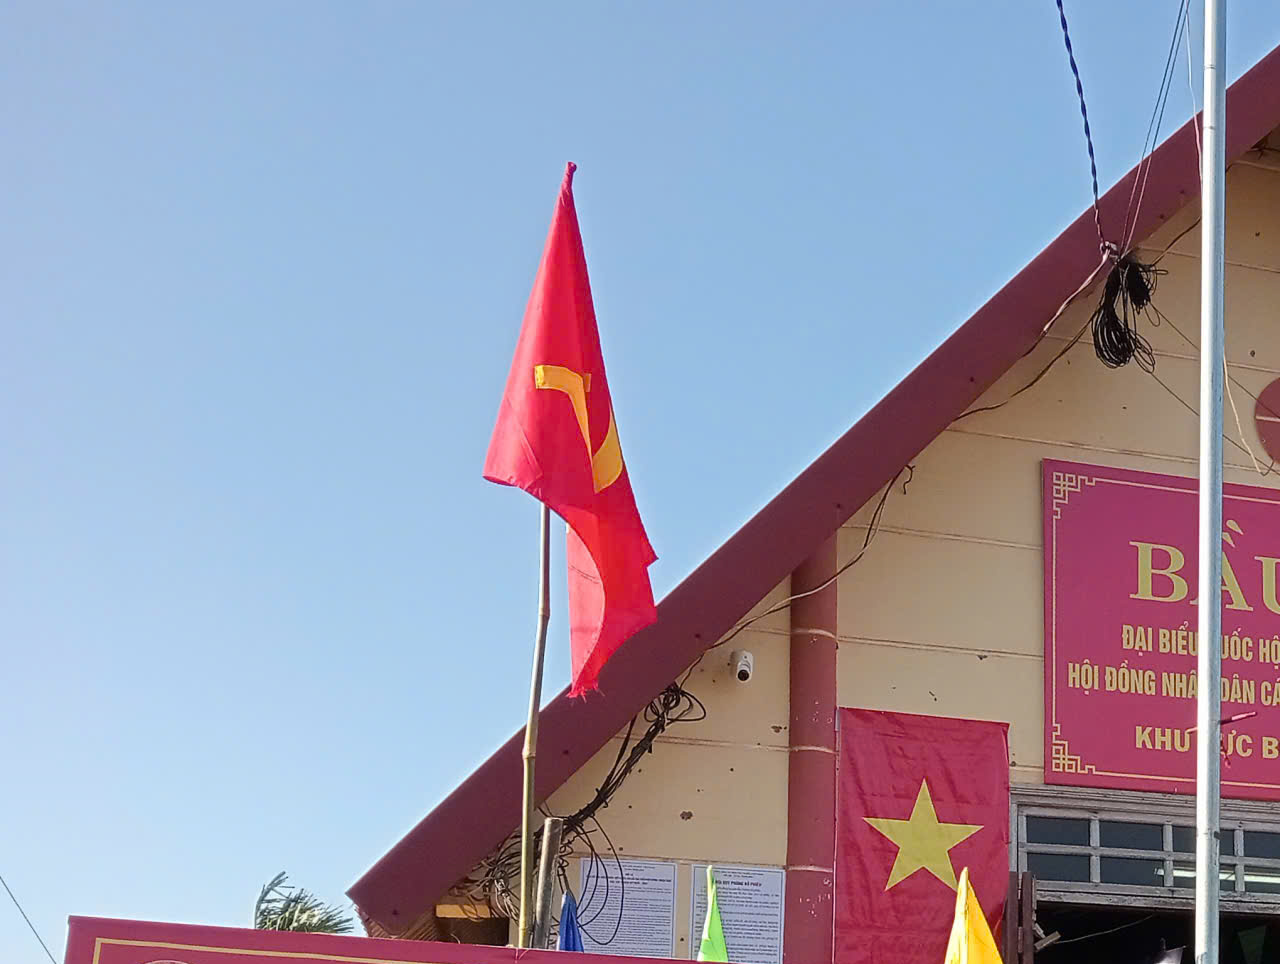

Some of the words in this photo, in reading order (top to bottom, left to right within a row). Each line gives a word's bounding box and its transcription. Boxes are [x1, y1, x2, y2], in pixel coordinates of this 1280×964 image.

[1121, 624, 1153, 657] ĐẠI
[1220, 628, 1253, 662] UỐC
[1068, 660, 1099, 695] HỘI
[1104, 659, 1156, 696] ĐỒNG
[1161, 668, 1198, 699] NHÂ
[1220, 673, 1255, 705] DÂN
[1135, 724, 1191, 753] KHU
